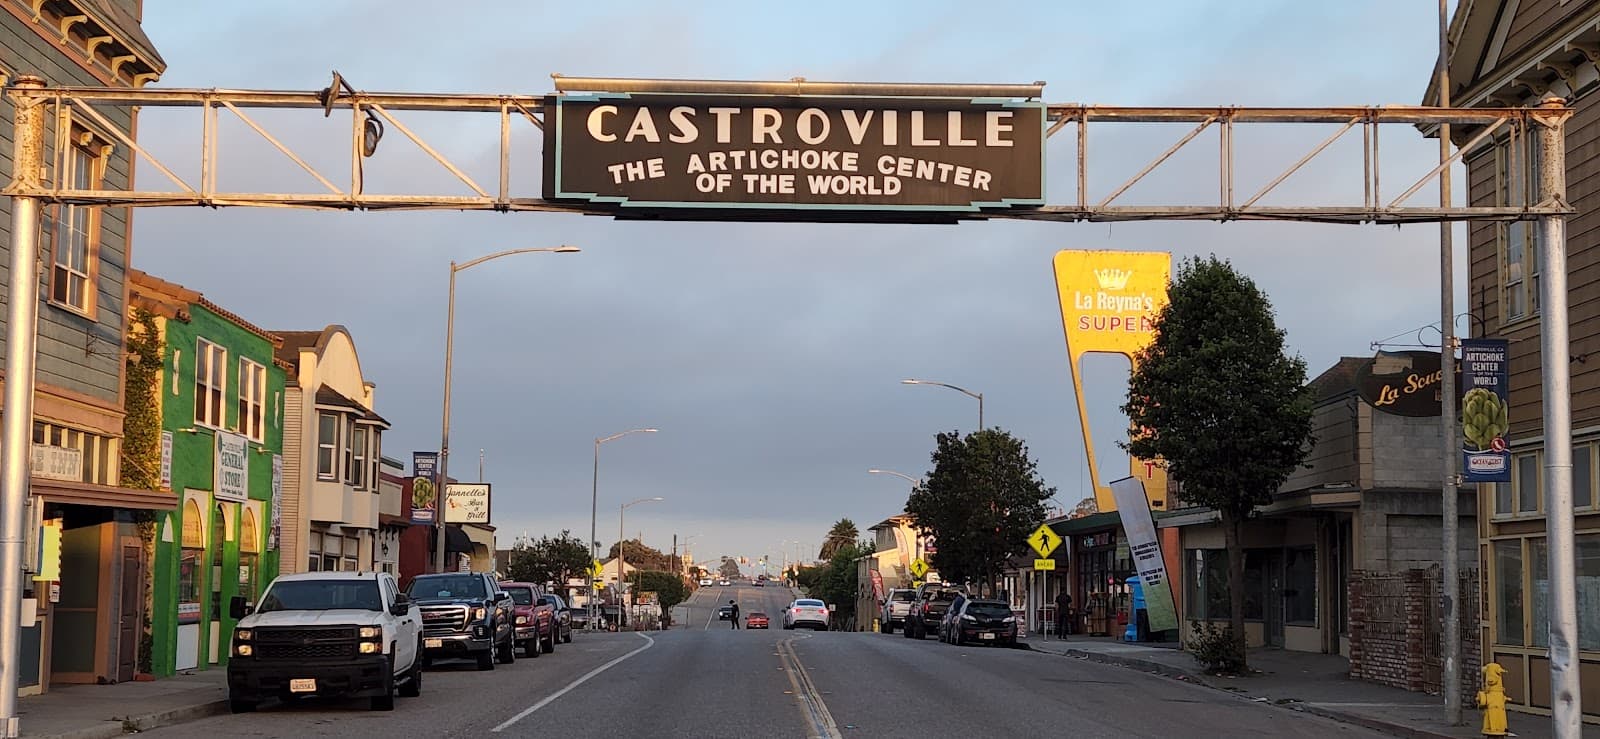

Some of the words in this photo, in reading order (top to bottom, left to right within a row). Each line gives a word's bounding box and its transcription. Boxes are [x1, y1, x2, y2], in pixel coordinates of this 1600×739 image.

[587, 105, 1014, 147] CASTROVILLE
[608, 158, 665, 184] THE
[687, 150, 859, 174] ARTICHOKE
[877, 155, 992, 191] CENTER
[696, 173, 732, 193] OF
[743, 174, 795, 194] THE
[807, 175, 902, 196] WORLD
[1075, 290, 1092, 310] La
[1097, 291, 1153, 312] Reyna's
[1466, 352, 1504, 361] ARTICHOKE
[1471, 362, 1499, 372] CENTER
[1473, 376, 1498, 386] WORLD
[1375, 384, 1400, 406] La
[221, 450, 243, 470] GENERAL
[224, 471, 241, 488] STORE
